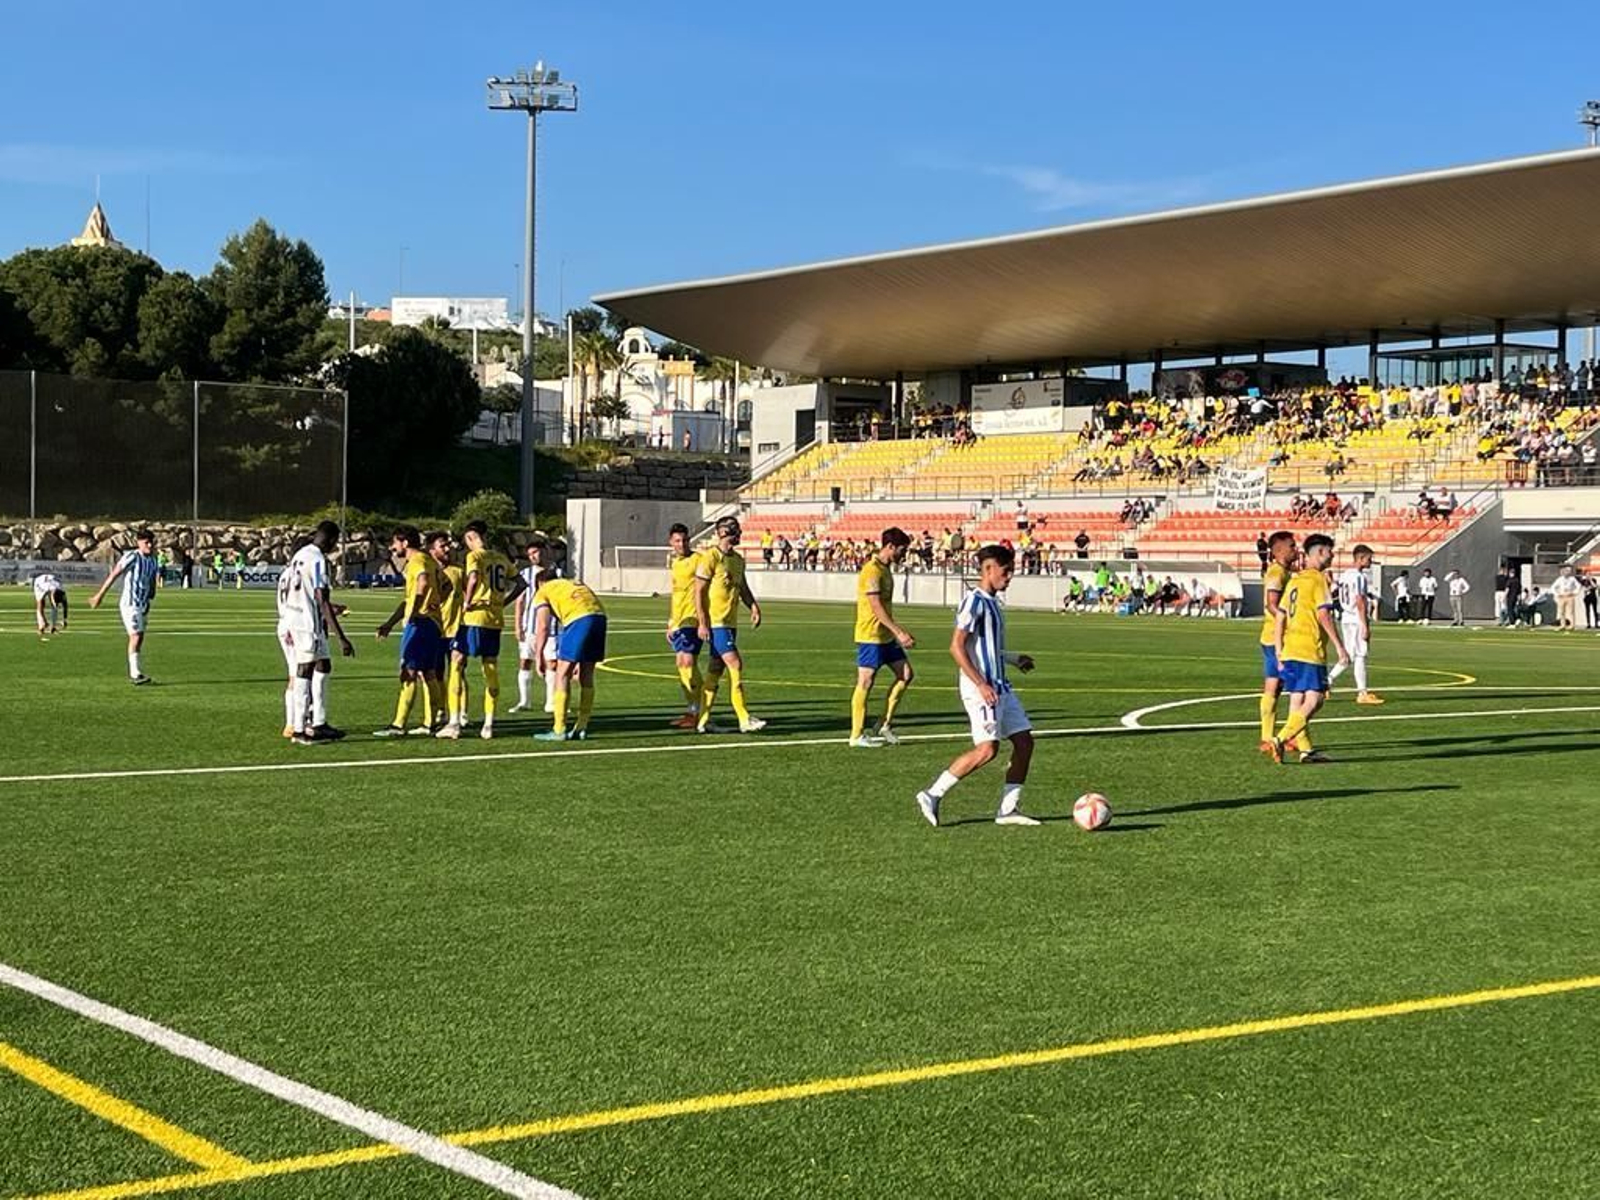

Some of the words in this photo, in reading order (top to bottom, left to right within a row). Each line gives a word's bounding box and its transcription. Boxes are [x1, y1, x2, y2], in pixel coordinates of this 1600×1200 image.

[487, 563, 505, 593] 16
[1288, 587, 1298, 618] 8
[980, 704, 997, 721] 11
